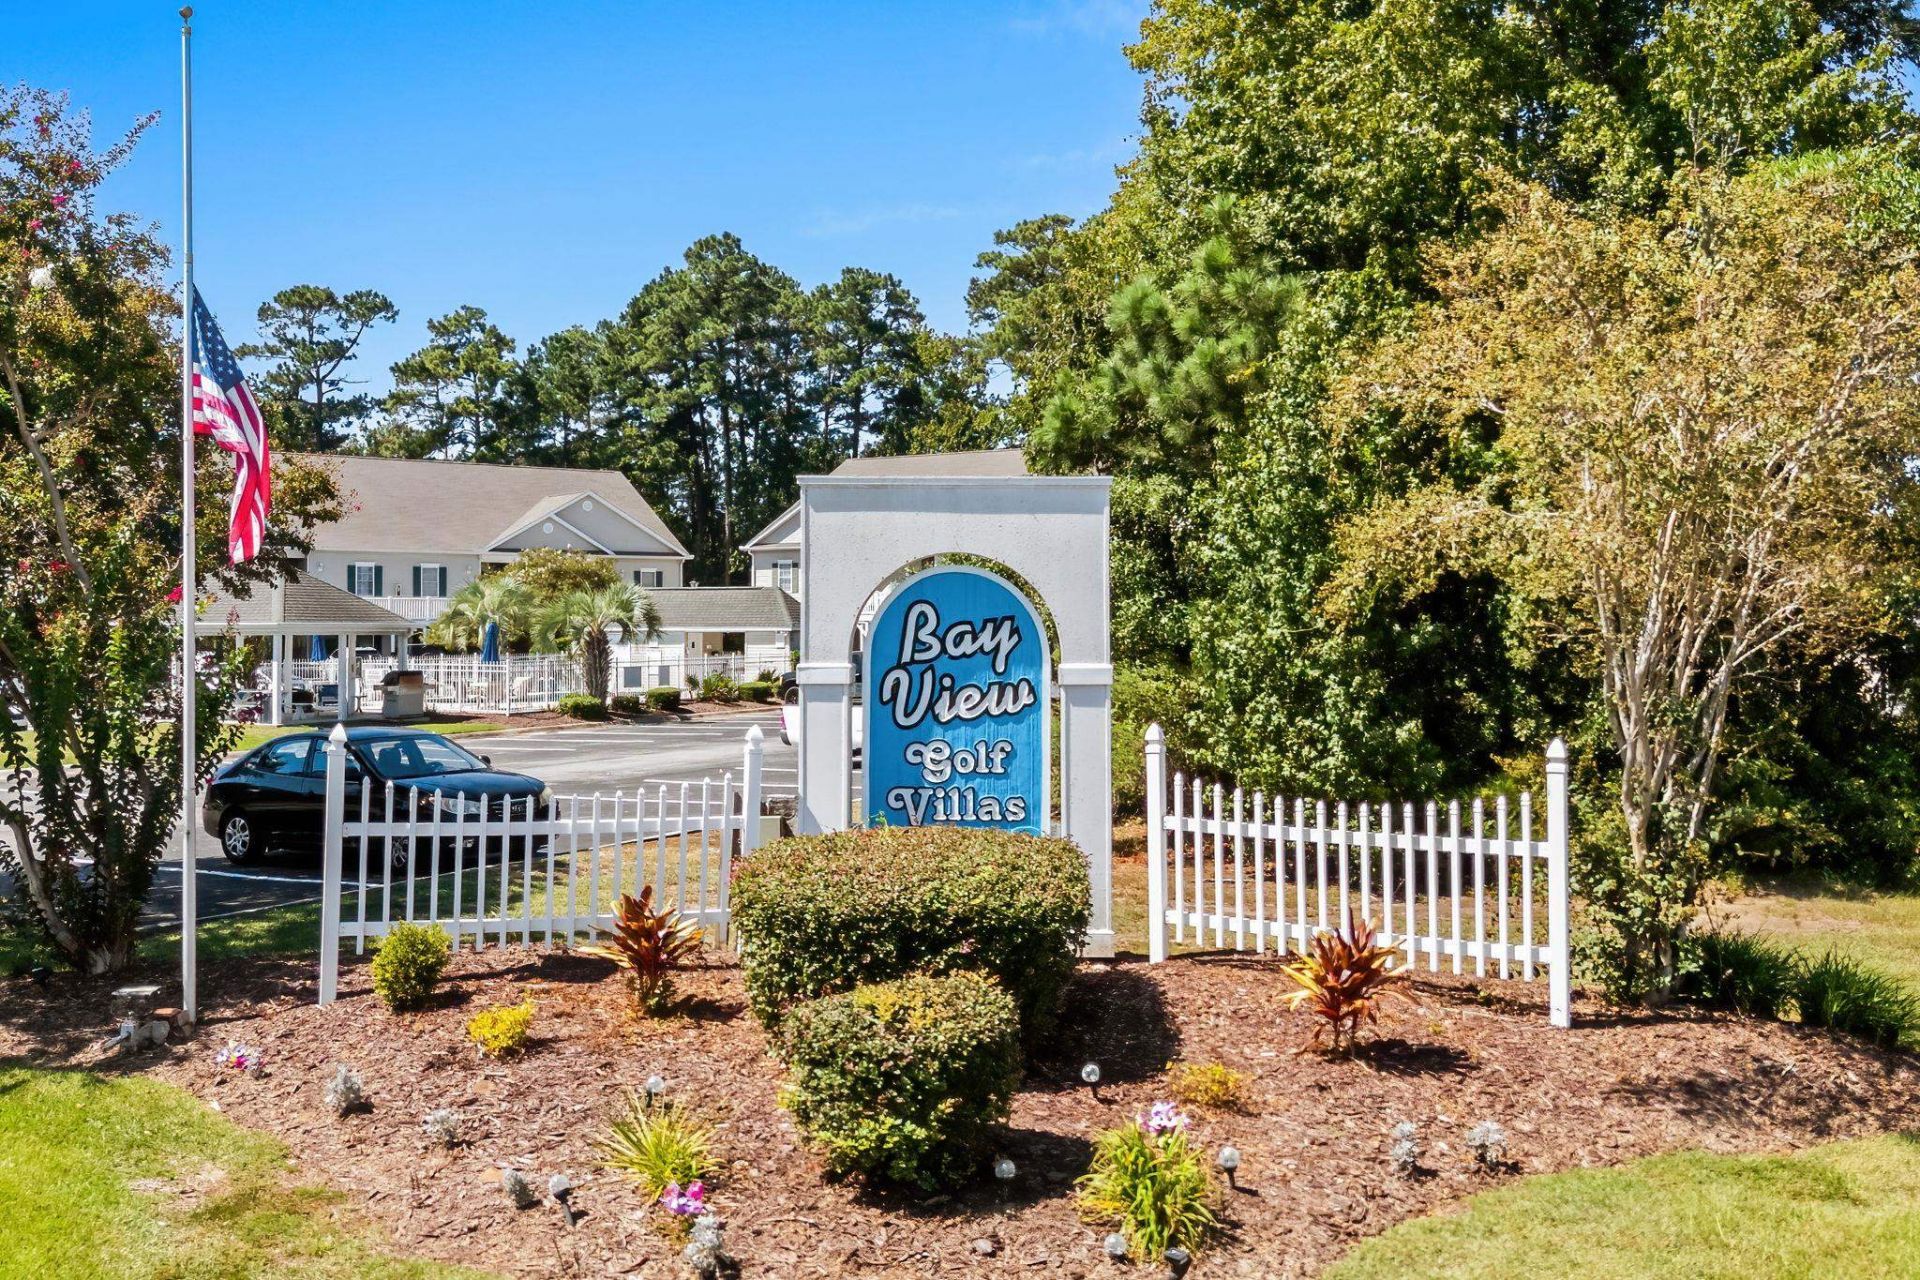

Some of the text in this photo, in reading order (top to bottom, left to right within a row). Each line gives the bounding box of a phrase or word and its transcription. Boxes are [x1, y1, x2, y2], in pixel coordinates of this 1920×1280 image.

[900, 600, 1022, 675] Bay
[880, 664, 1037, 729] View
[905, 738, 1012, 783] Golf
[887, 786, 1026, 826] Villas
